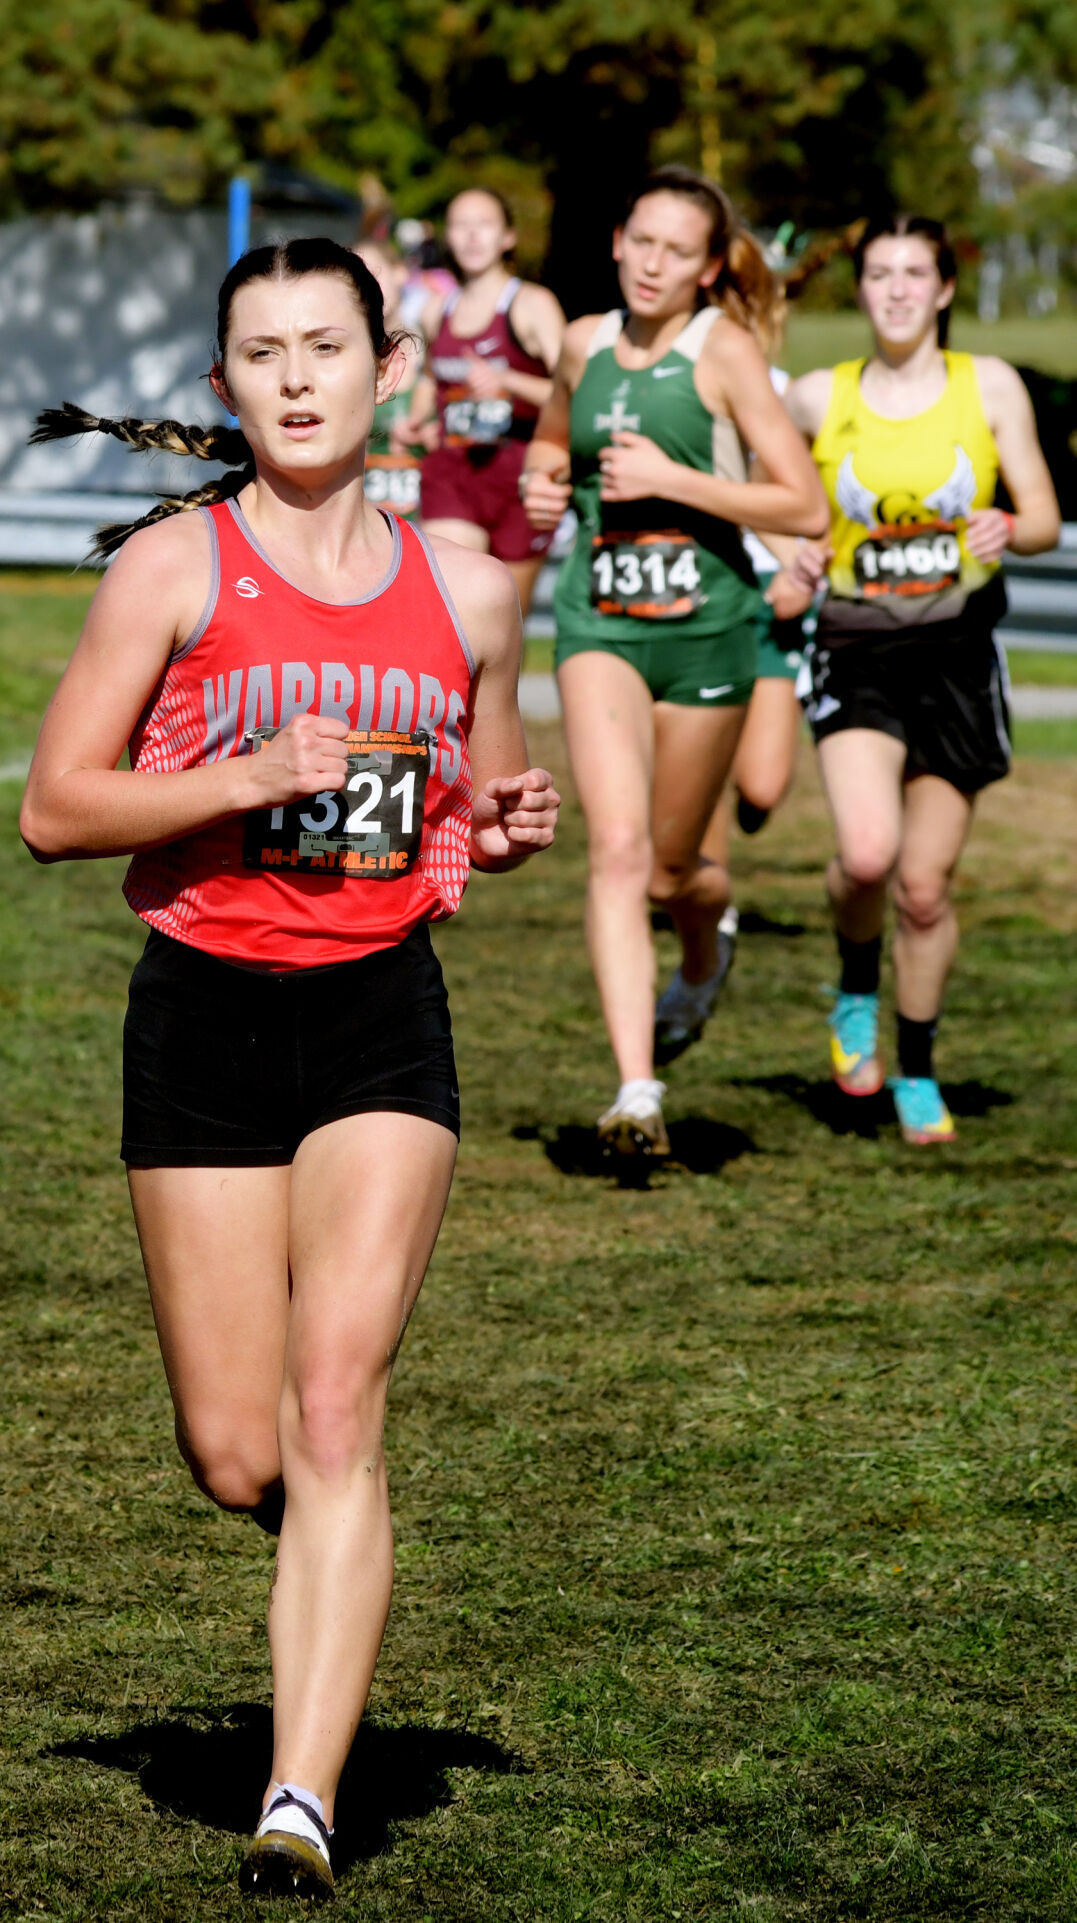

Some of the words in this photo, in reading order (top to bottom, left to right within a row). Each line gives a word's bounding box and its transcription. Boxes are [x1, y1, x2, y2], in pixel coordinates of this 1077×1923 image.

[855, 534, 960, 578] 1460
[593, 549, 700, 595] 1314
[202, 661, 467, 786] WARRIORS
[345, 731, 368, 742] IGH
[369, 731, 412, 744] SCHOOL
[346, 743, 428, 756] HAMPIONSHIPS
[303, 833, 325, 841] 01321
[310, 851, 409, 870] ATHLETIC
